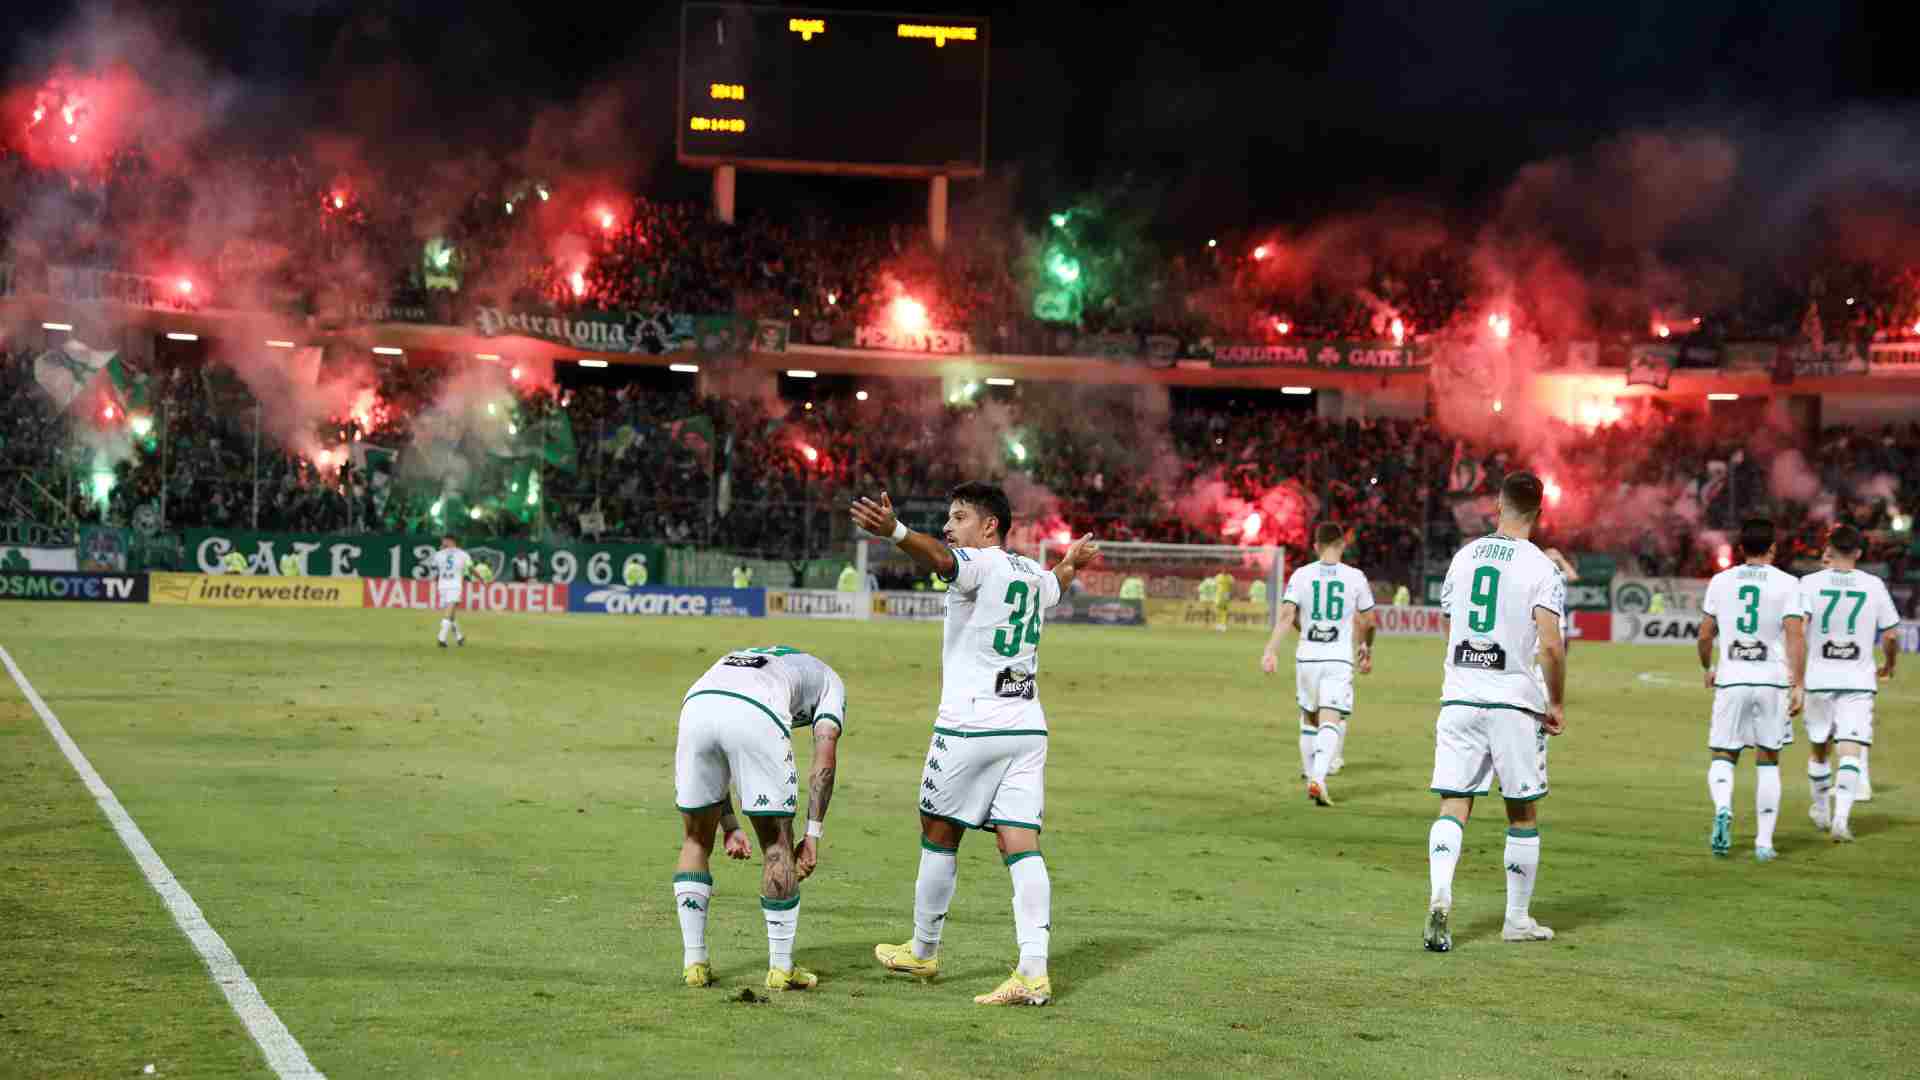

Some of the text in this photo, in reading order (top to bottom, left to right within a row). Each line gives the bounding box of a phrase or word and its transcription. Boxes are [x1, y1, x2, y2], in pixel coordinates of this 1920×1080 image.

[197, 537, 362, 577] GATE
[101, 577, 135, 597] TV
[199, 579, 341, 601] interwetten
[465, 581, 566, 612] HOTEL
[1311, 579, 1345, 621] 16
[1468, 565, 1501, 633] 9
[992, 580, 1041, 657] 34
[1736, 585, 1761, 634] 3
[1820, 589, 1868, 634] 77
[1461, 649, 1499, 666] Fuego
